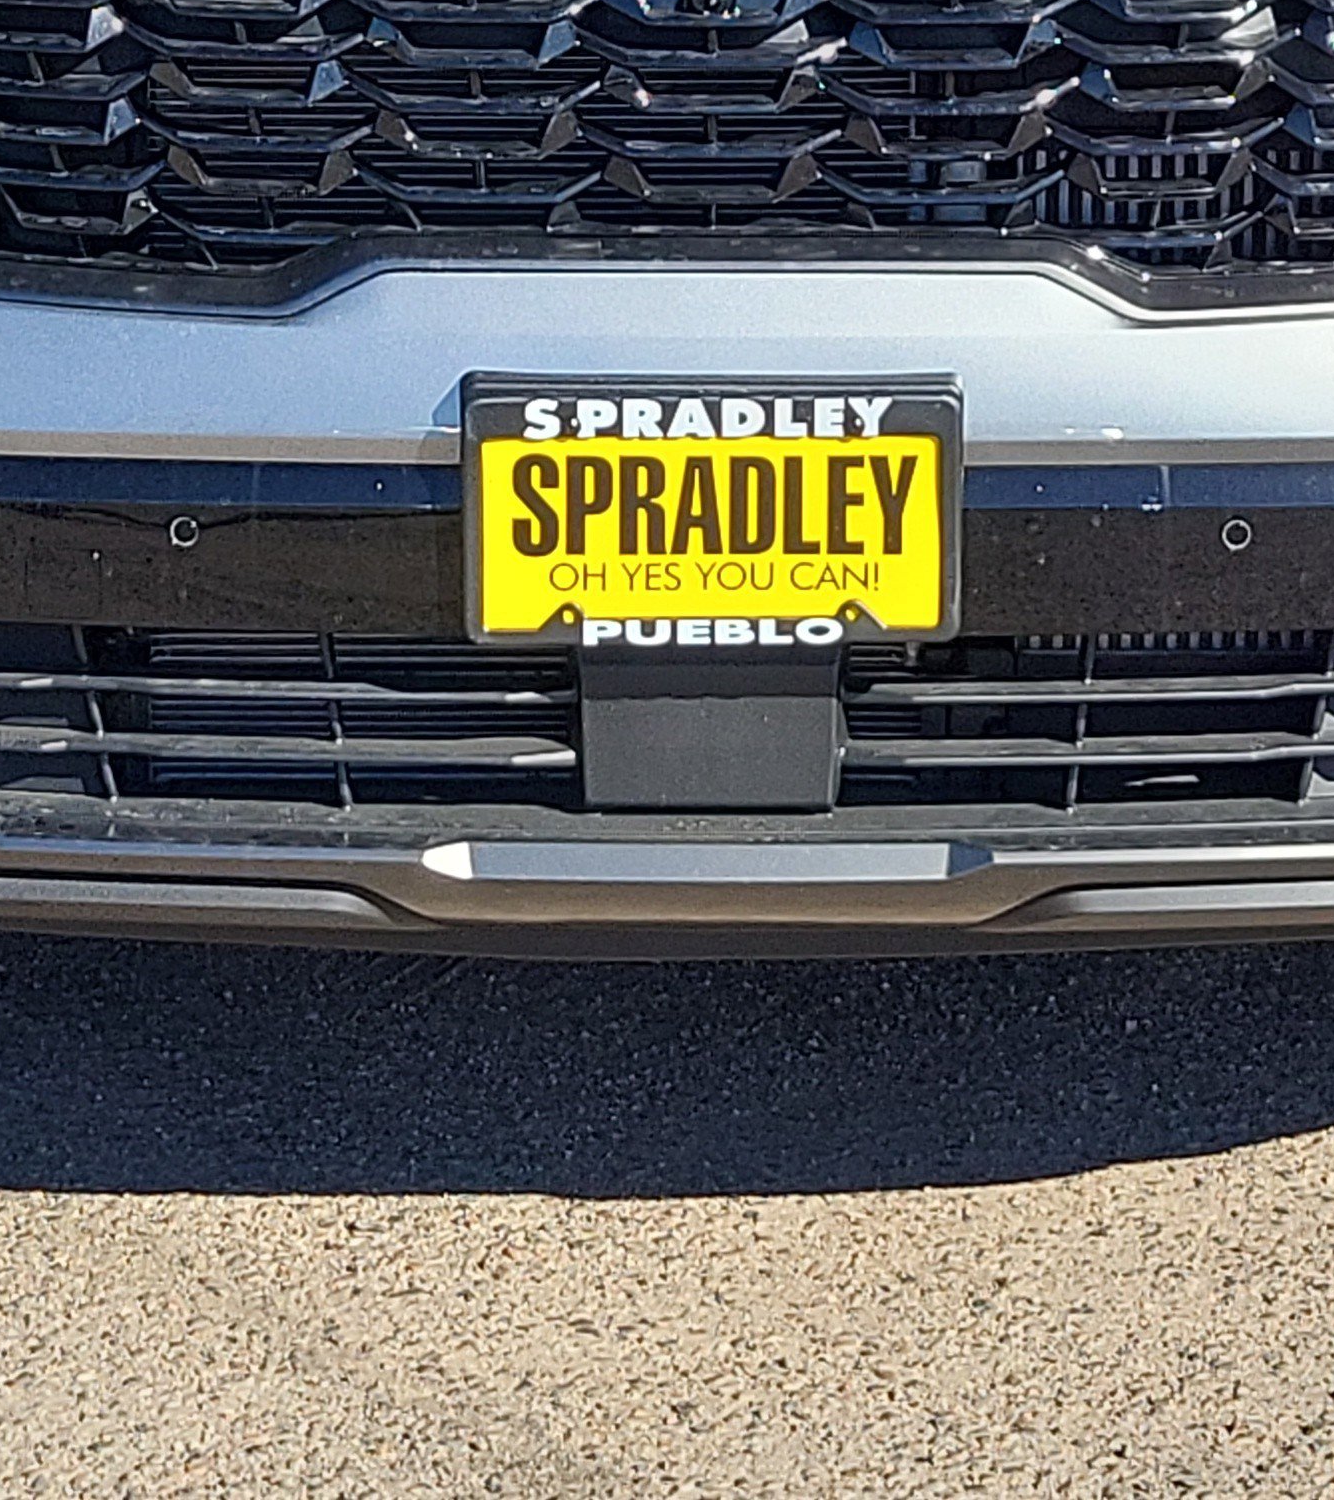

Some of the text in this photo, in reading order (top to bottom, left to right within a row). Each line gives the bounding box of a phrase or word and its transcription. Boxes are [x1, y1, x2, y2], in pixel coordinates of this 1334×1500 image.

[523, 397, 893, 441] SPRADLEY
[511, 453, 919, 558] SPRADLEY
[549, 561, 880, 592] OH YES YOU CAN!
[582, 617, 845, 646] PUEBLO
